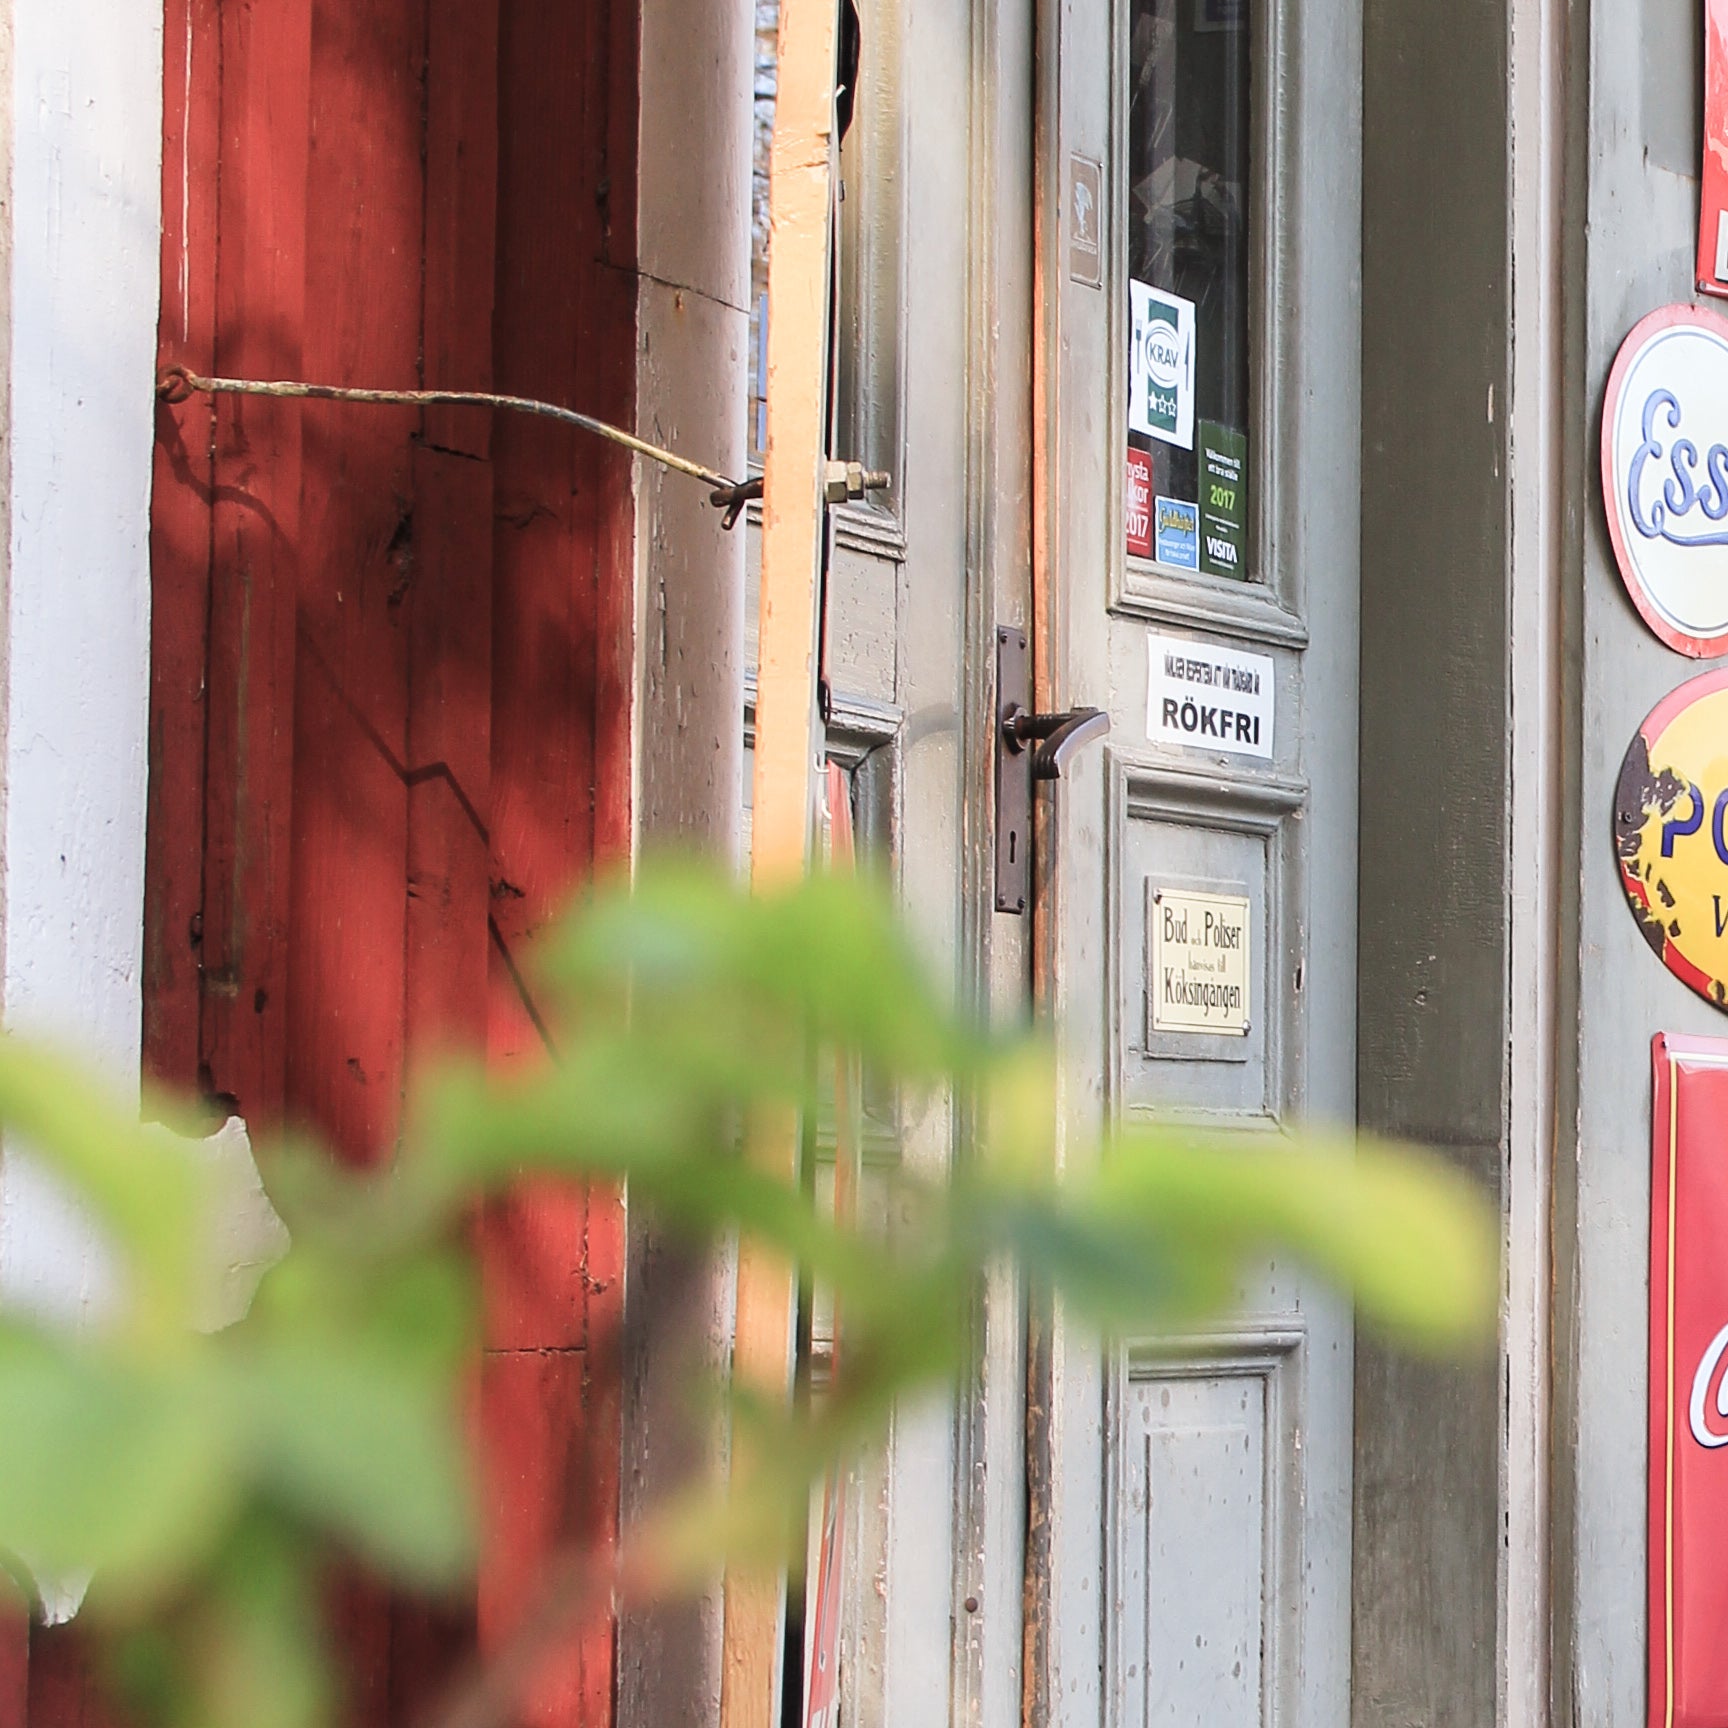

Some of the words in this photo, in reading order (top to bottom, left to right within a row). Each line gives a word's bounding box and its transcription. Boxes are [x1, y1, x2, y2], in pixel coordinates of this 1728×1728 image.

[1149, 342, 1179, 368] KRAV
[1210, 484, 1235, 511] 2017
[1206, 536, 1238, 563] VISITA
[1162, 695, 1260, 745] RÖKFRI
[1164, 907, 1188, 943] Bud
